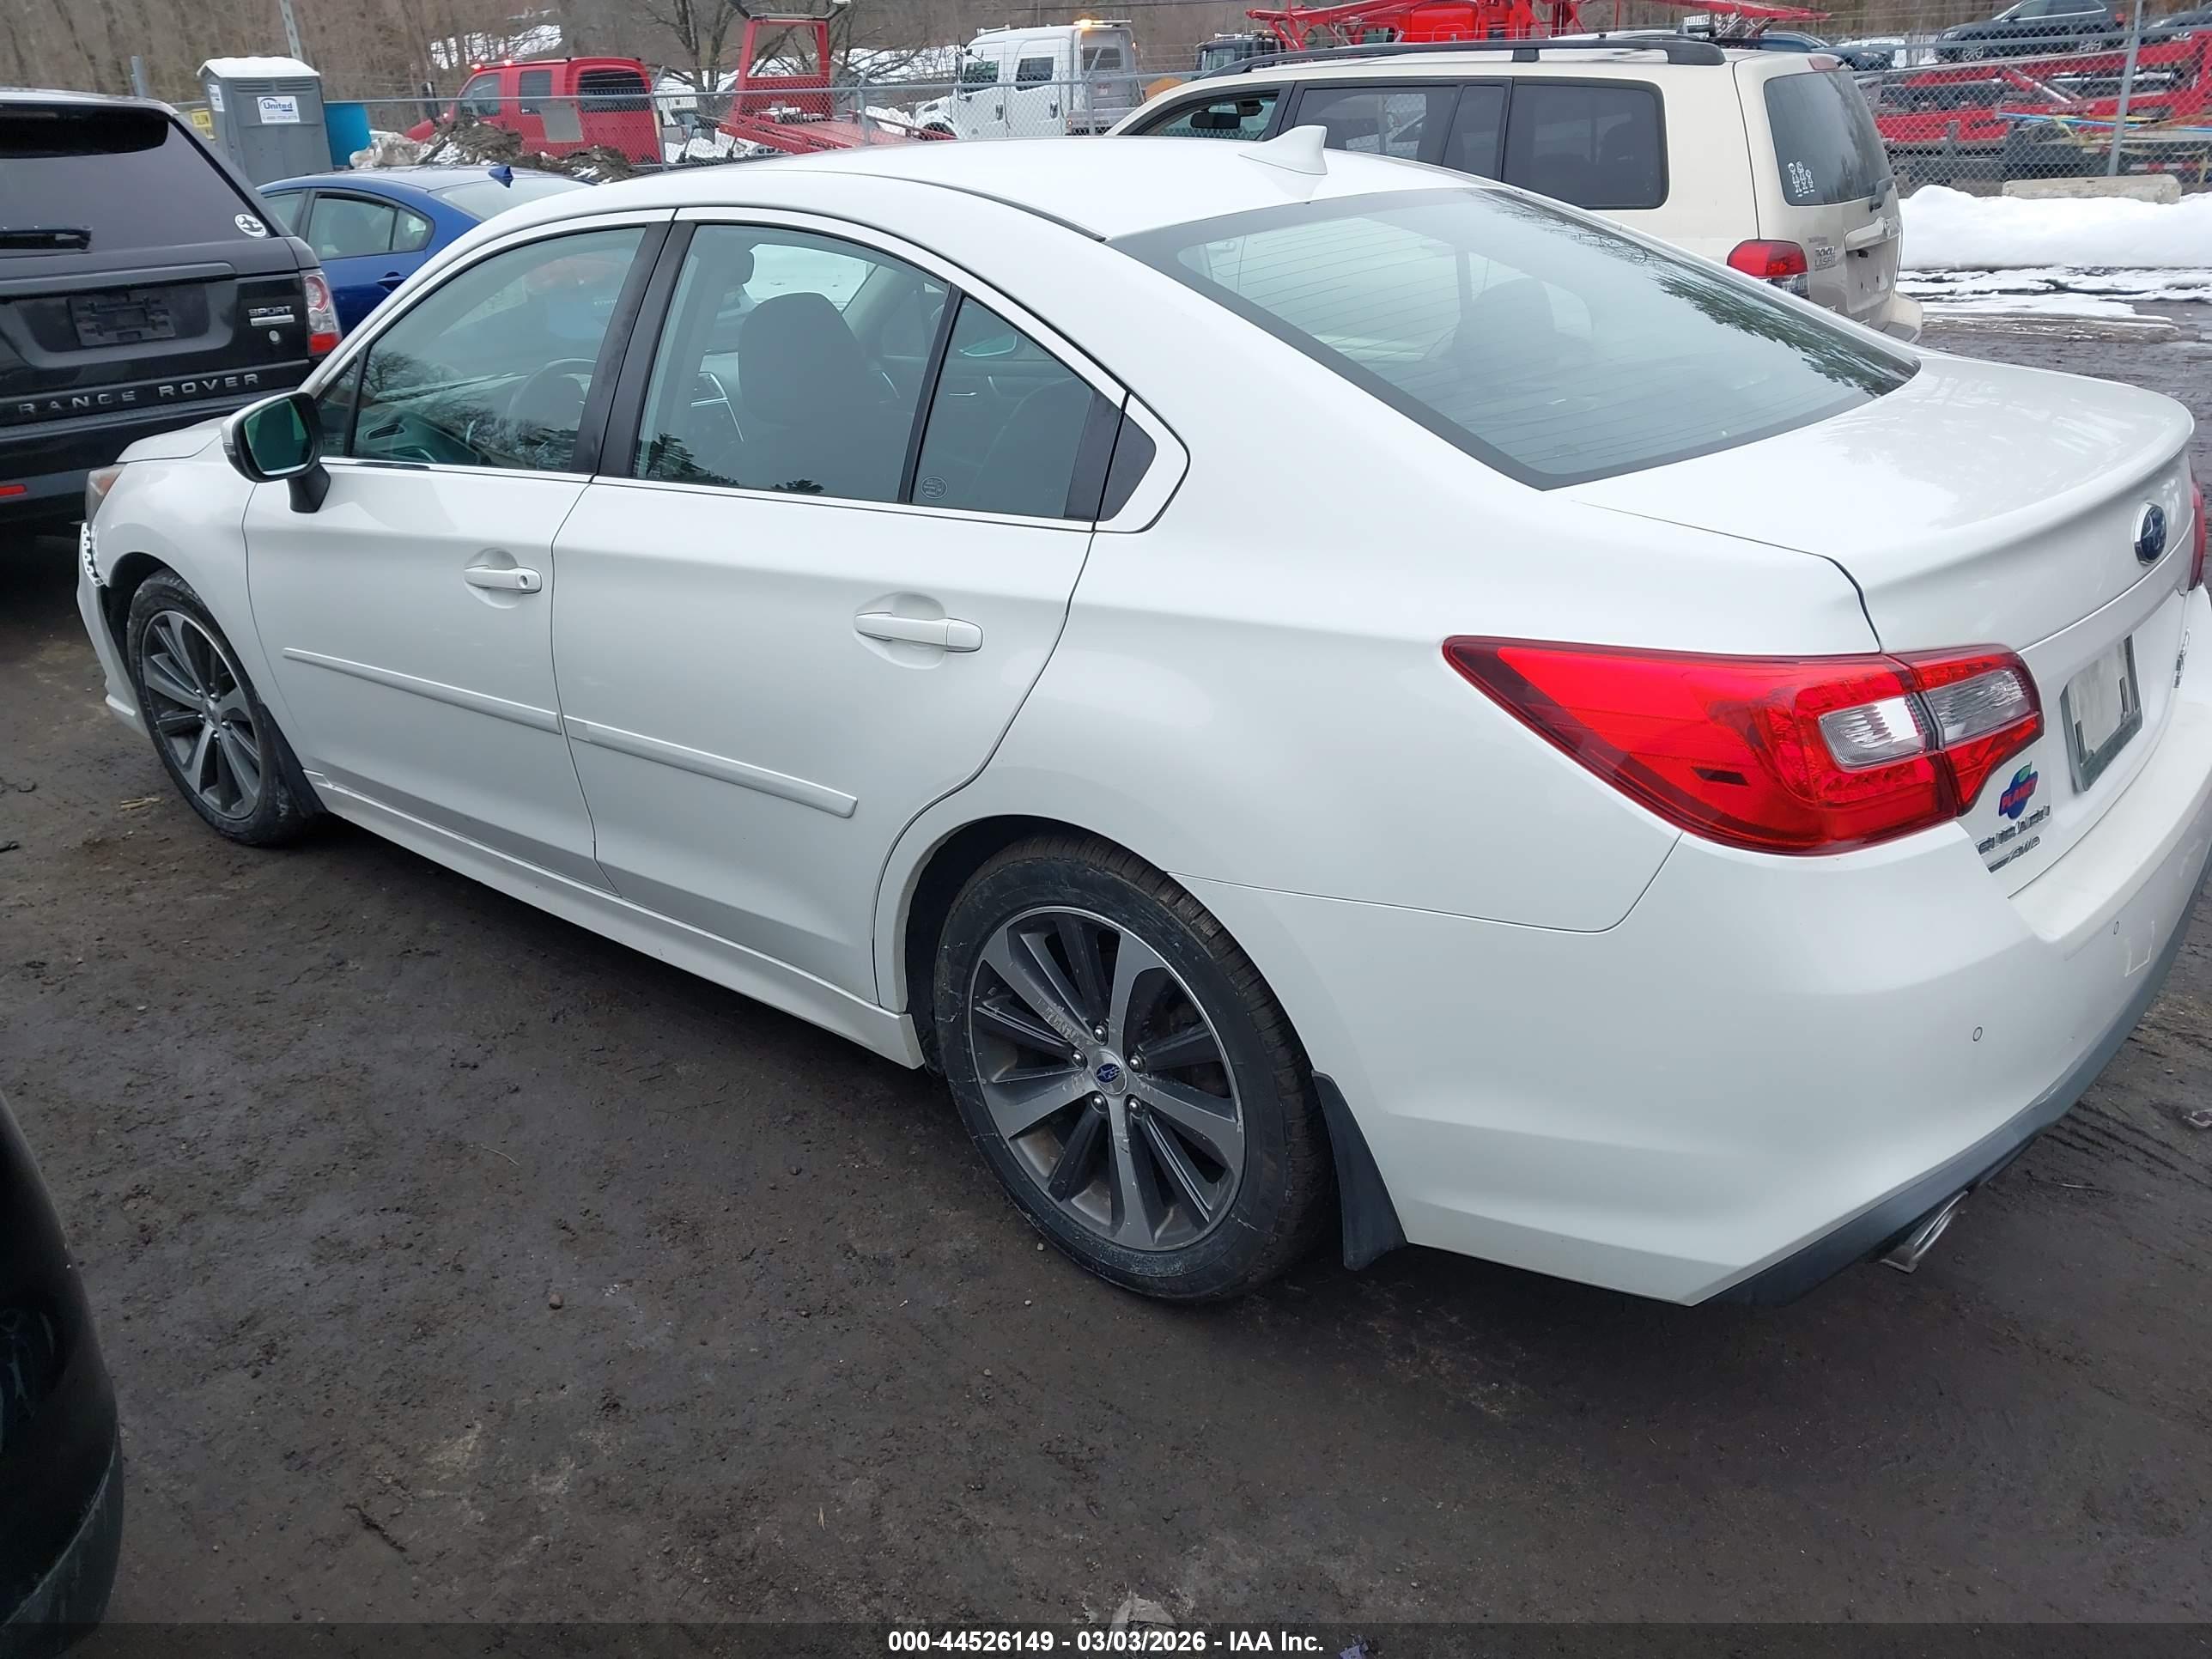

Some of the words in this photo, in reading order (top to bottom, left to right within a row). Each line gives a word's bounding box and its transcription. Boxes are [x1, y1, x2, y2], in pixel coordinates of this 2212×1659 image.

[263, 101, 294, 110] United
[247, 306, 292, 317] SPORT
[17, 391, 137, 414] RANGE
[158, 373, 258, 398] ROVER
[2001, 776, 2038, 812] PLANET
[2008, 836, 2041, 864] AWD
